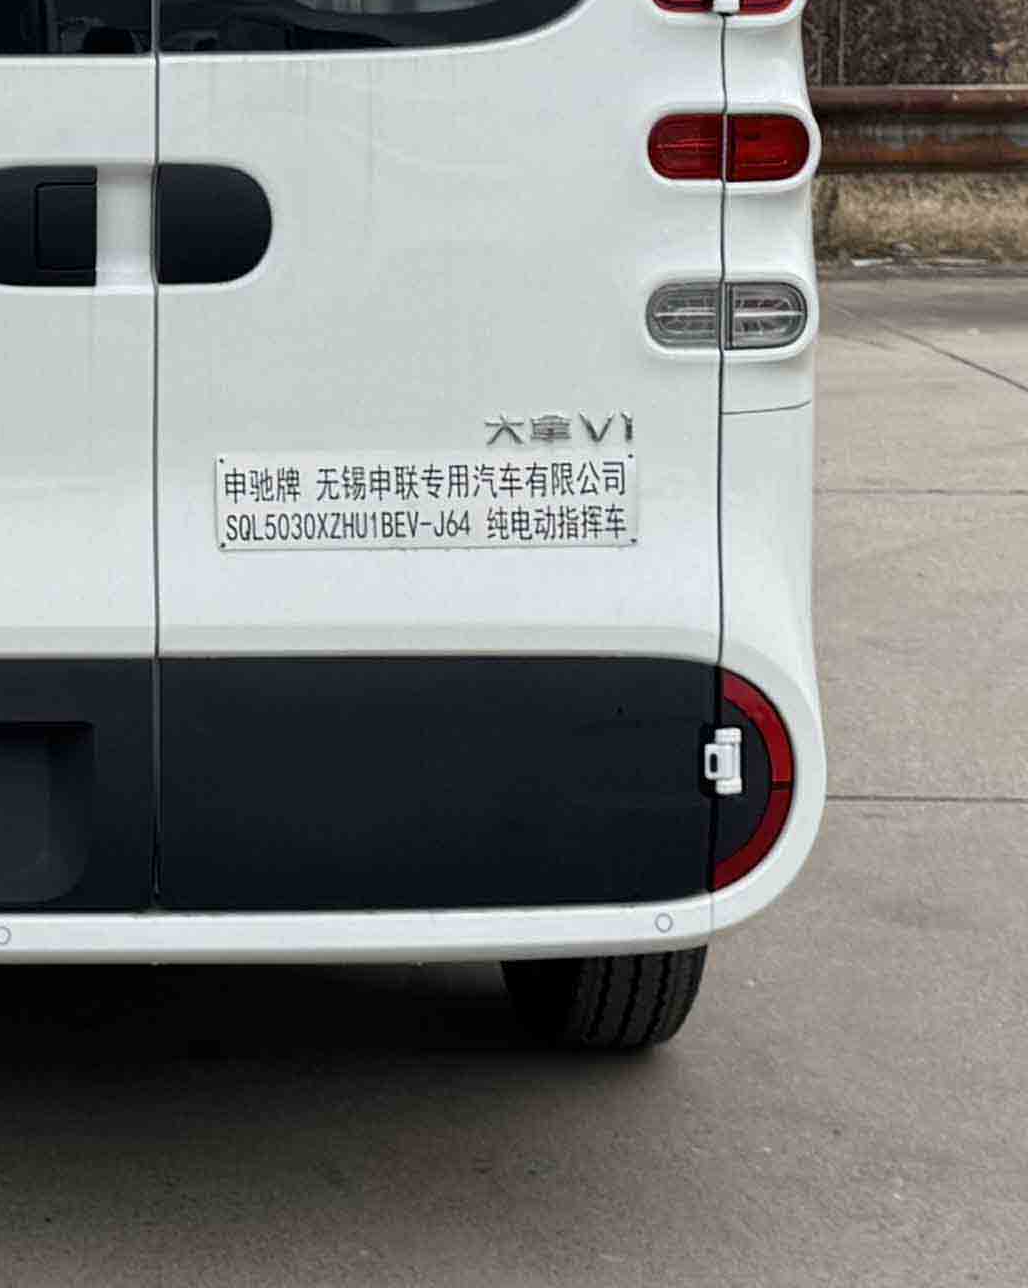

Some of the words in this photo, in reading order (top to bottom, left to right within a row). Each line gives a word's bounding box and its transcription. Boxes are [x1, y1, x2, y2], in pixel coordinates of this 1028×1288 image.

[224, 467, 301, 503] 申驰牌
[316, 461, 627, 501] 无锡申联专用汽车有限公司
[226, 510, 471, 541] SQL5030XZHU1BEV-J64
[486, 503, 628, 540] 纯电动指挥车
